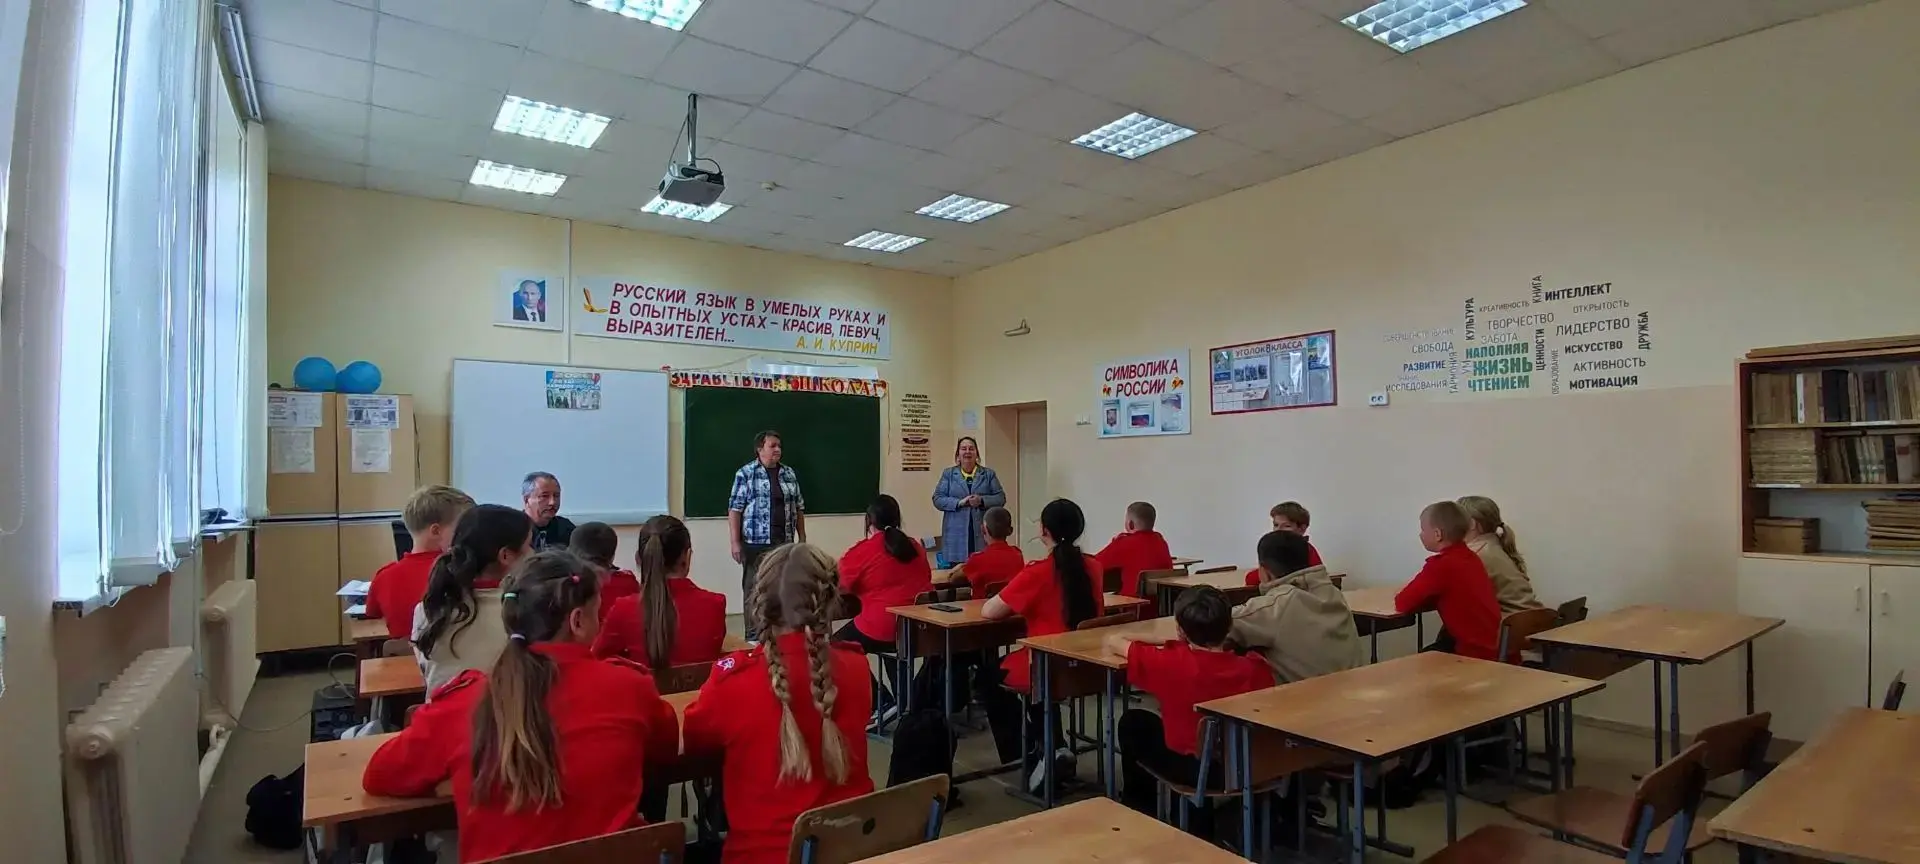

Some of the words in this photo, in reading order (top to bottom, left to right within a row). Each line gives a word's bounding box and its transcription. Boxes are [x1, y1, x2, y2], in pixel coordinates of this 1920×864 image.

[1532, 274, 1542, 304] КНИГА
[1545, 282, 1612, 302] ИНТЕЛЛЕКТ
[613, 283, 687, 304] РУССКИЙ
[695, 292, 737, 310] ЯЗЫК
[745, 298, 755, 312] В
[762, 300, 822, 319] УМЕЛЫХ
[829, 308, 871, 324] РУКАХ
[877, 314, 886, 326] И
[1479, 300, 1530, 312] КРЕАТИВНОСТЬ
[1573, 300, 1630, 314] ОТКРЫТОСТЬ
[610, 300, 621, 315] В
[630, 302, 712, 324] ОПЫТНЫХ
[720, 312, 768, 329] УСТАХ
[782, 318, 834, 338] КРАСИВ,
[839, 325, 881, 342] ПЕВУЧ,
[1465, 297, 1475, 341] КУЛЬТУРА
[1488, 312, 1554, 330] ТВОРЧЕСТВО
[1556, 318, 1630, 336] ЛИДЕРСТВО
[606, 318, 735, 343] ВЫРАЗИТЕЛЕН...
[1480, 332, 1519, 344] ЗАБОТА
[1637, 311, 1651, 350] ДРУЖБА
[796, 336, 808, 349] А.
[814, 337, 824, 350] И.
[829, 339, 878, 354] КУПРИН
[1235, 345, 1266, 357] УГОЛОК
[1271, 340, 1303, 352] КЛАССА
[1412, 341, 1454, 354] СВОБОДА
[1466, 342, 1529, 359] НАПОЛНЯЯ
[1536, 328, 1546, 371] ЦЕННОСТИ
[1564, 340, 1623, 354] ИСКУССТВО
[1104, 358, 1179, 382] СИМВОЛИКА
[1403, 360, 1447, 372] РАЗВИТИЕ
[1448, 352, 1459, 394] ГАРМОНИЯ
[1474, 356, 1533, 376] ЖИЗНЬ
[1552, 348, 1560, 395] ОБРАЗОВАНИЕ
[1573, 358, 1646, 372] АКТИВНОСТЬ
[1115, 378, 1166, 398] РОССИИ
[1385, 380, 1448, 392] ИССЛЕДОВАНИЯ
[1468, 375, 1530, 392] ЧТЕНИЕМ
[1570, 376, 1638, 390] МОТИВАЦИЯ
